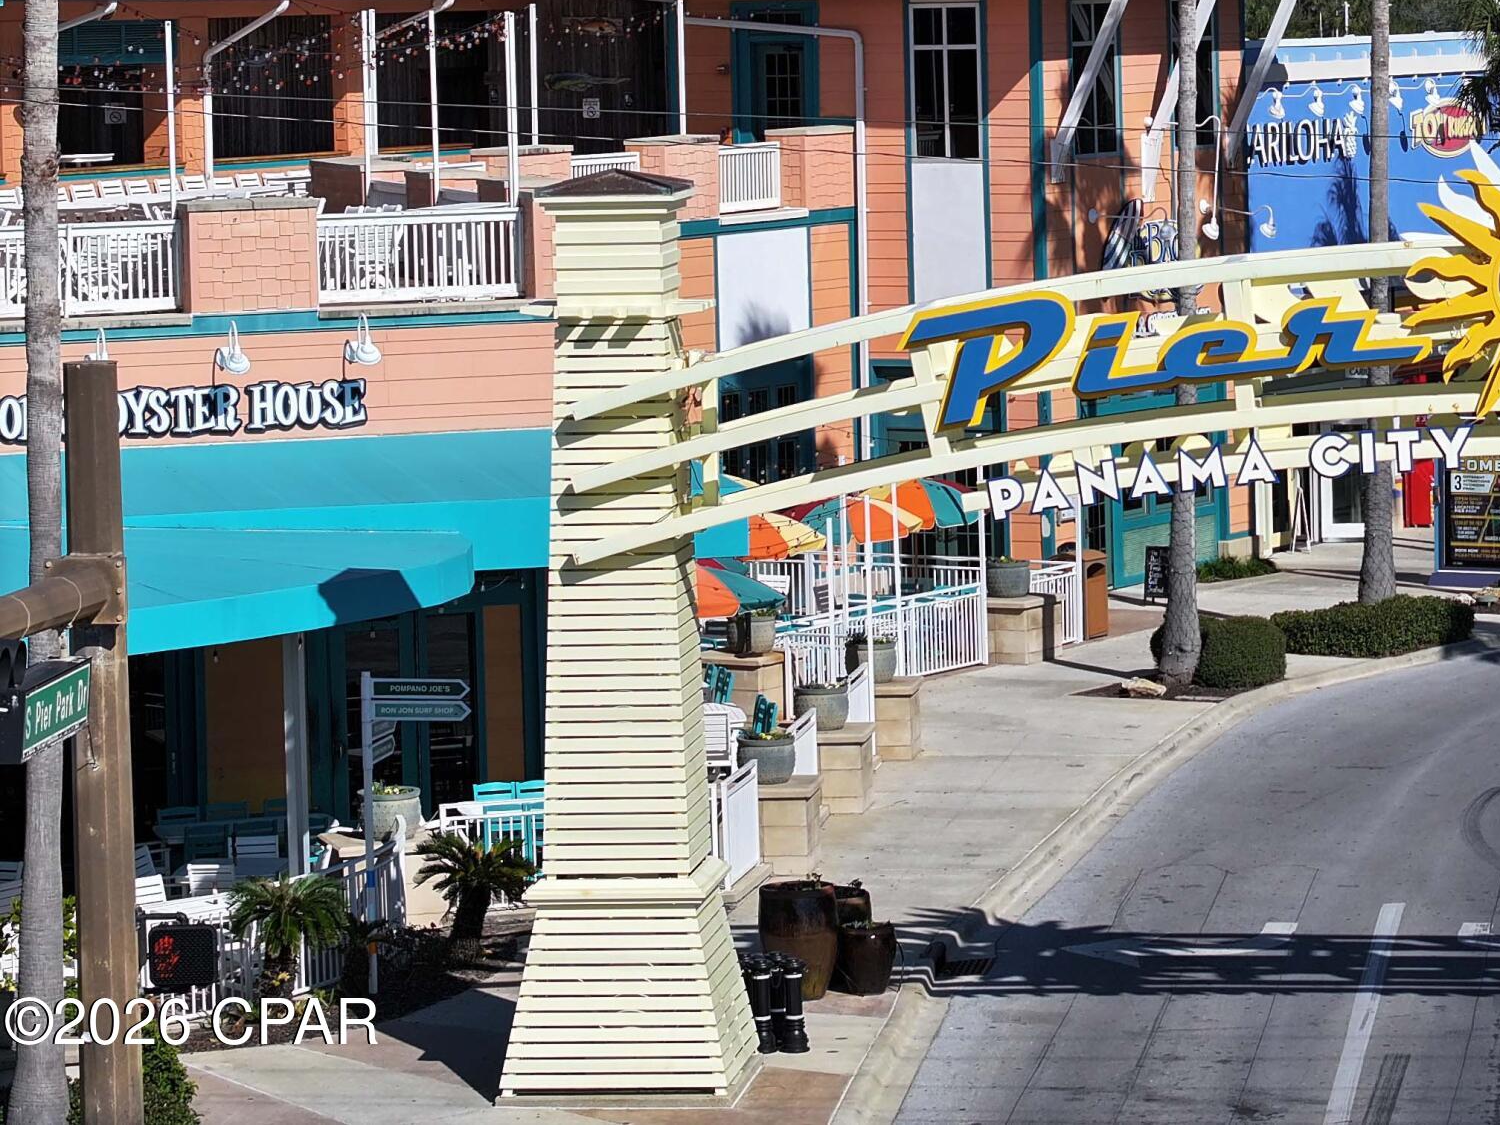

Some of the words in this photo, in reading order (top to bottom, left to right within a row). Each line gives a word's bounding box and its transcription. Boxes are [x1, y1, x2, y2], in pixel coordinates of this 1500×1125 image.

[1247, 118, 1347, 165] ARILOHA
[898, 290, 1432, 433] Pier
[248, 377, 367, 432] HOUSE
[988, 435, 1280, 520] PANAMA
[1309, 425, 1473, 478] CITY
[1454, 475, 1462, 490] 3
[25, 706, 32, 740] S
[35, 700, 53, 735] Pier
[55, 685, 74, 724] Park
[77, 678, 88, 713] Dr
[390, 685, 427, 693] POMPANO
